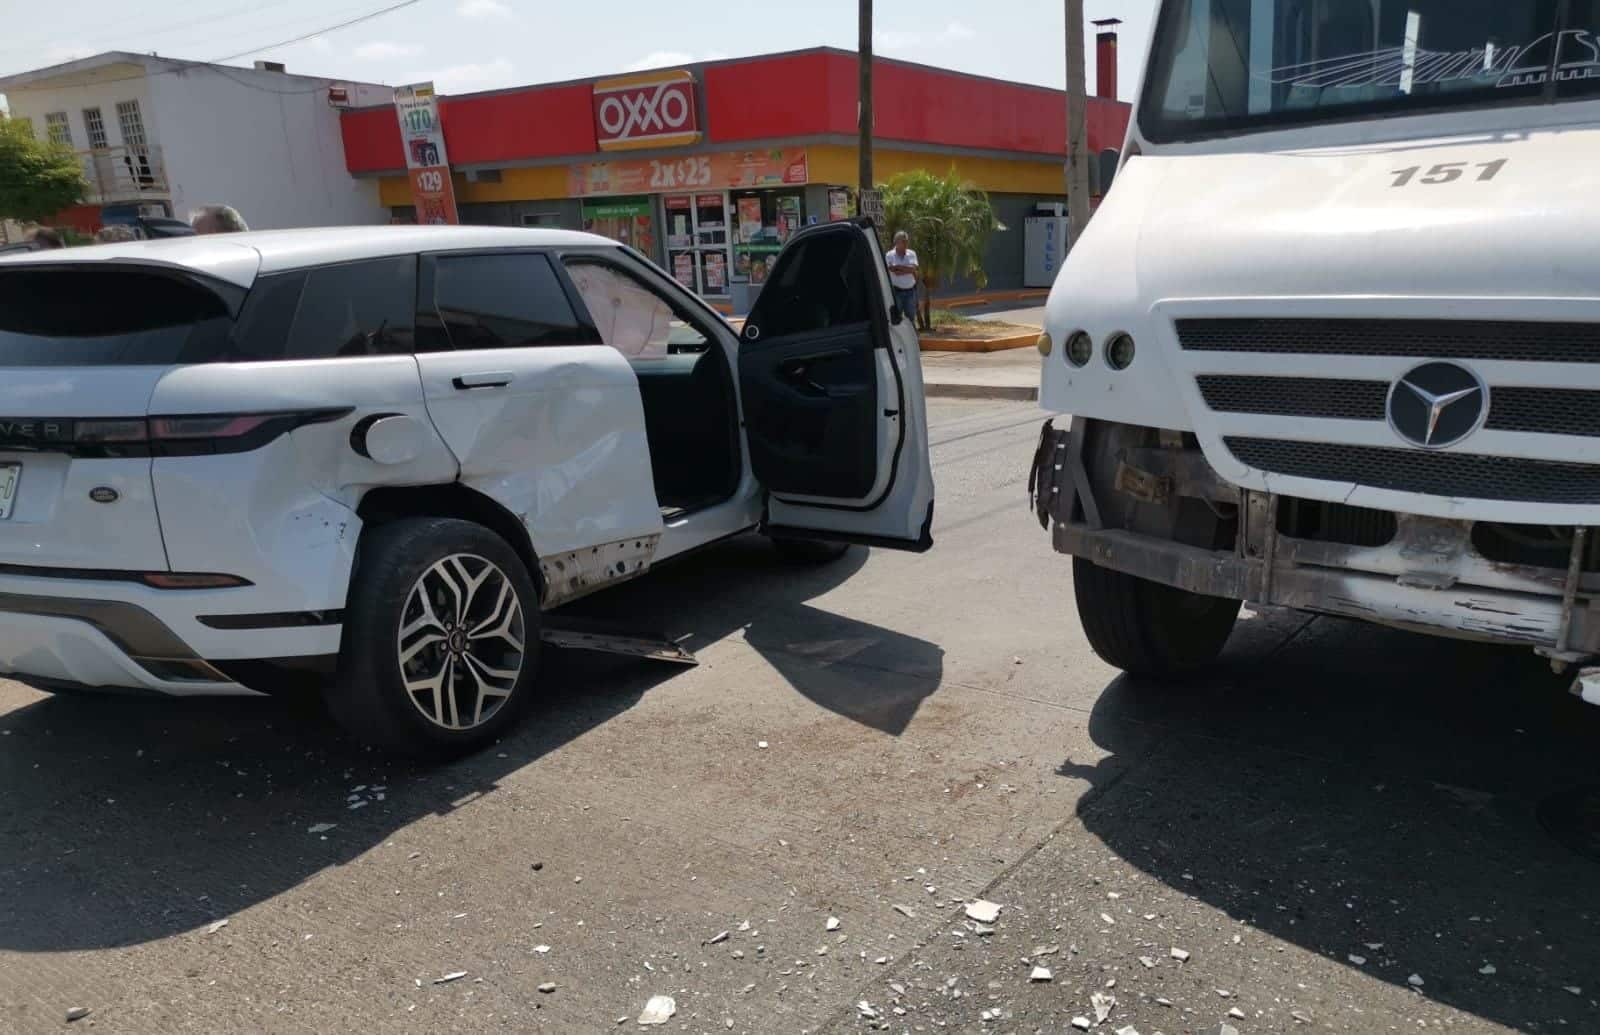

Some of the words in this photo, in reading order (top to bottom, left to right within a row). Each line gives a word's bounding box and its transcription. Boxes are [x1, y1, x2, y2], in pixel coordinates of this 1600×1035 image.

[600, 84, 688, 139] OXXO
[417, 170, 442, 193] $129
[1391, 159, 1508, 187] 151
